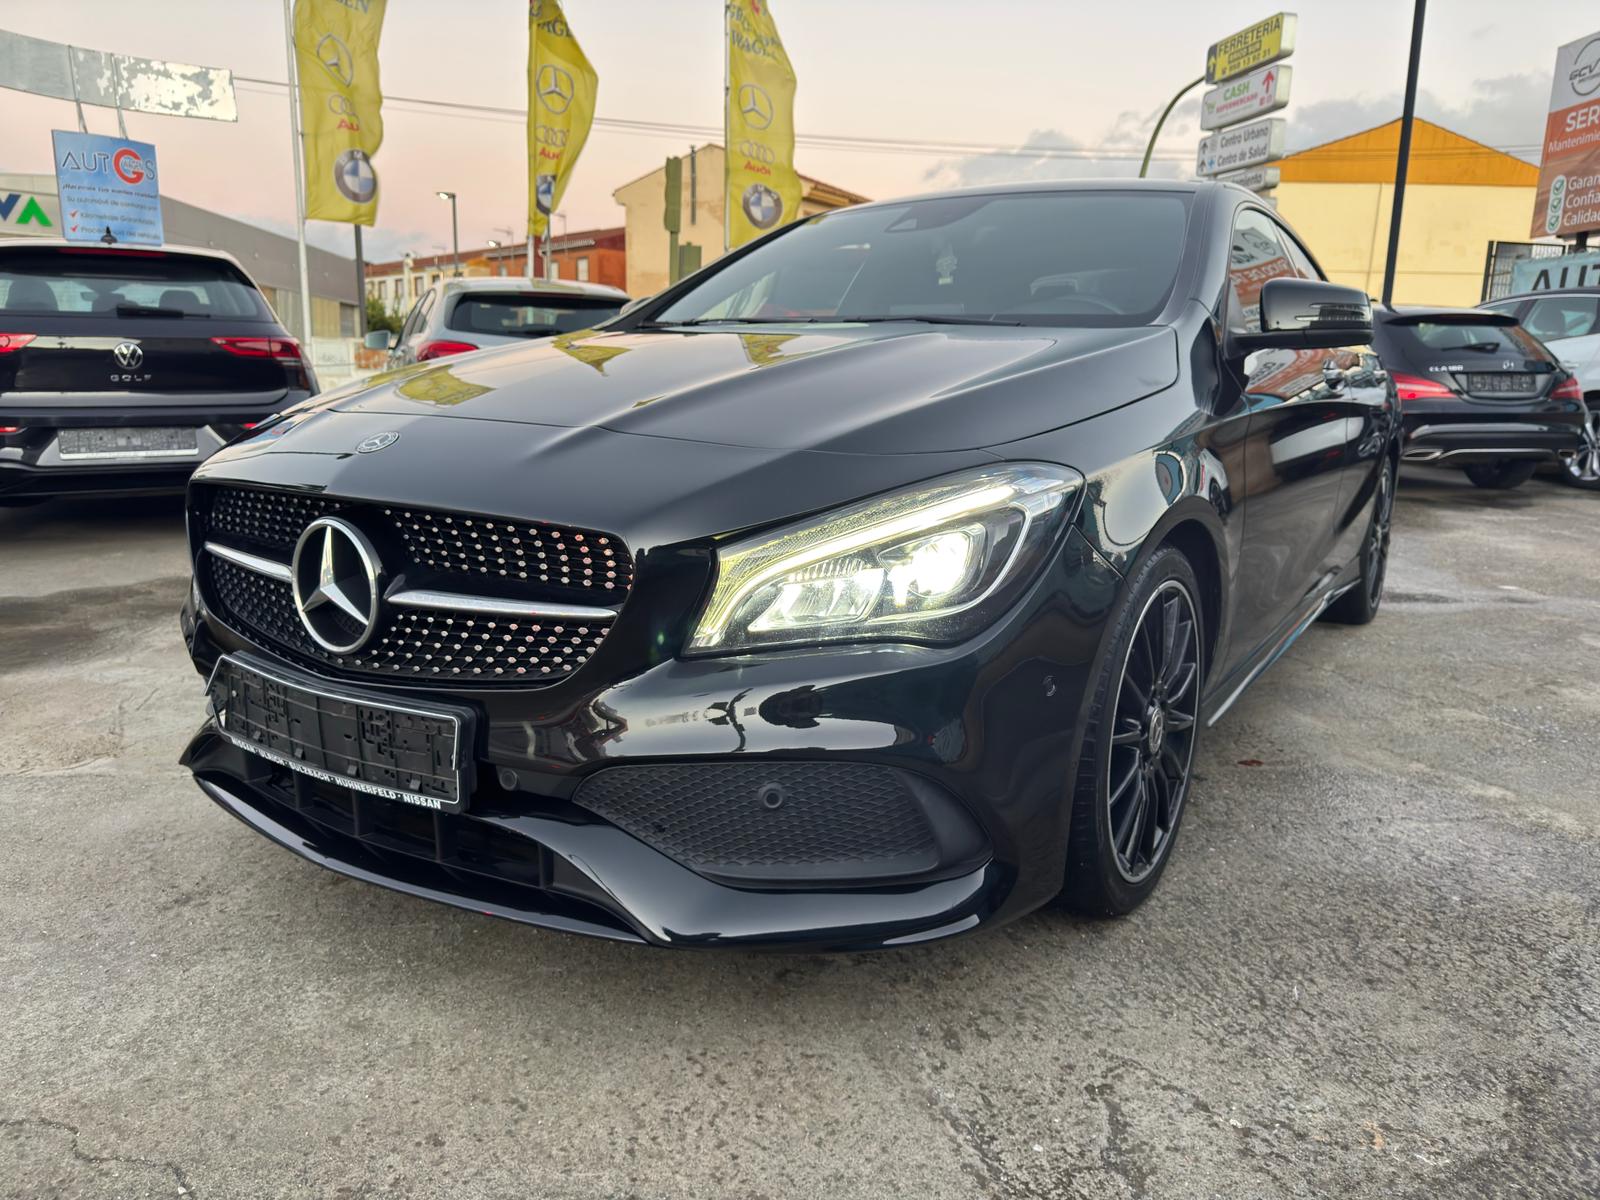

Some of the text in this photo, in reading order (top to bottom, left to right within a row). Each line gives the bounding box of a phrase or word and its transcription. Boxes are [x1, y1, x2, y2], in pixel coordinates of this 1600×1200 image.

[1219, 17, 1280, 54] FERRETERIA
[1224, 80, 1250, 101] CASH
[1565, 104, 1600, 132] SER
[1221, 126, 1269, 148] Centro Urbano
[1217, 143, 1268, 167] Centro de Salud
[110, 374, 152, 382] GOLF
[402, 793, 441, 810] NISSAN
